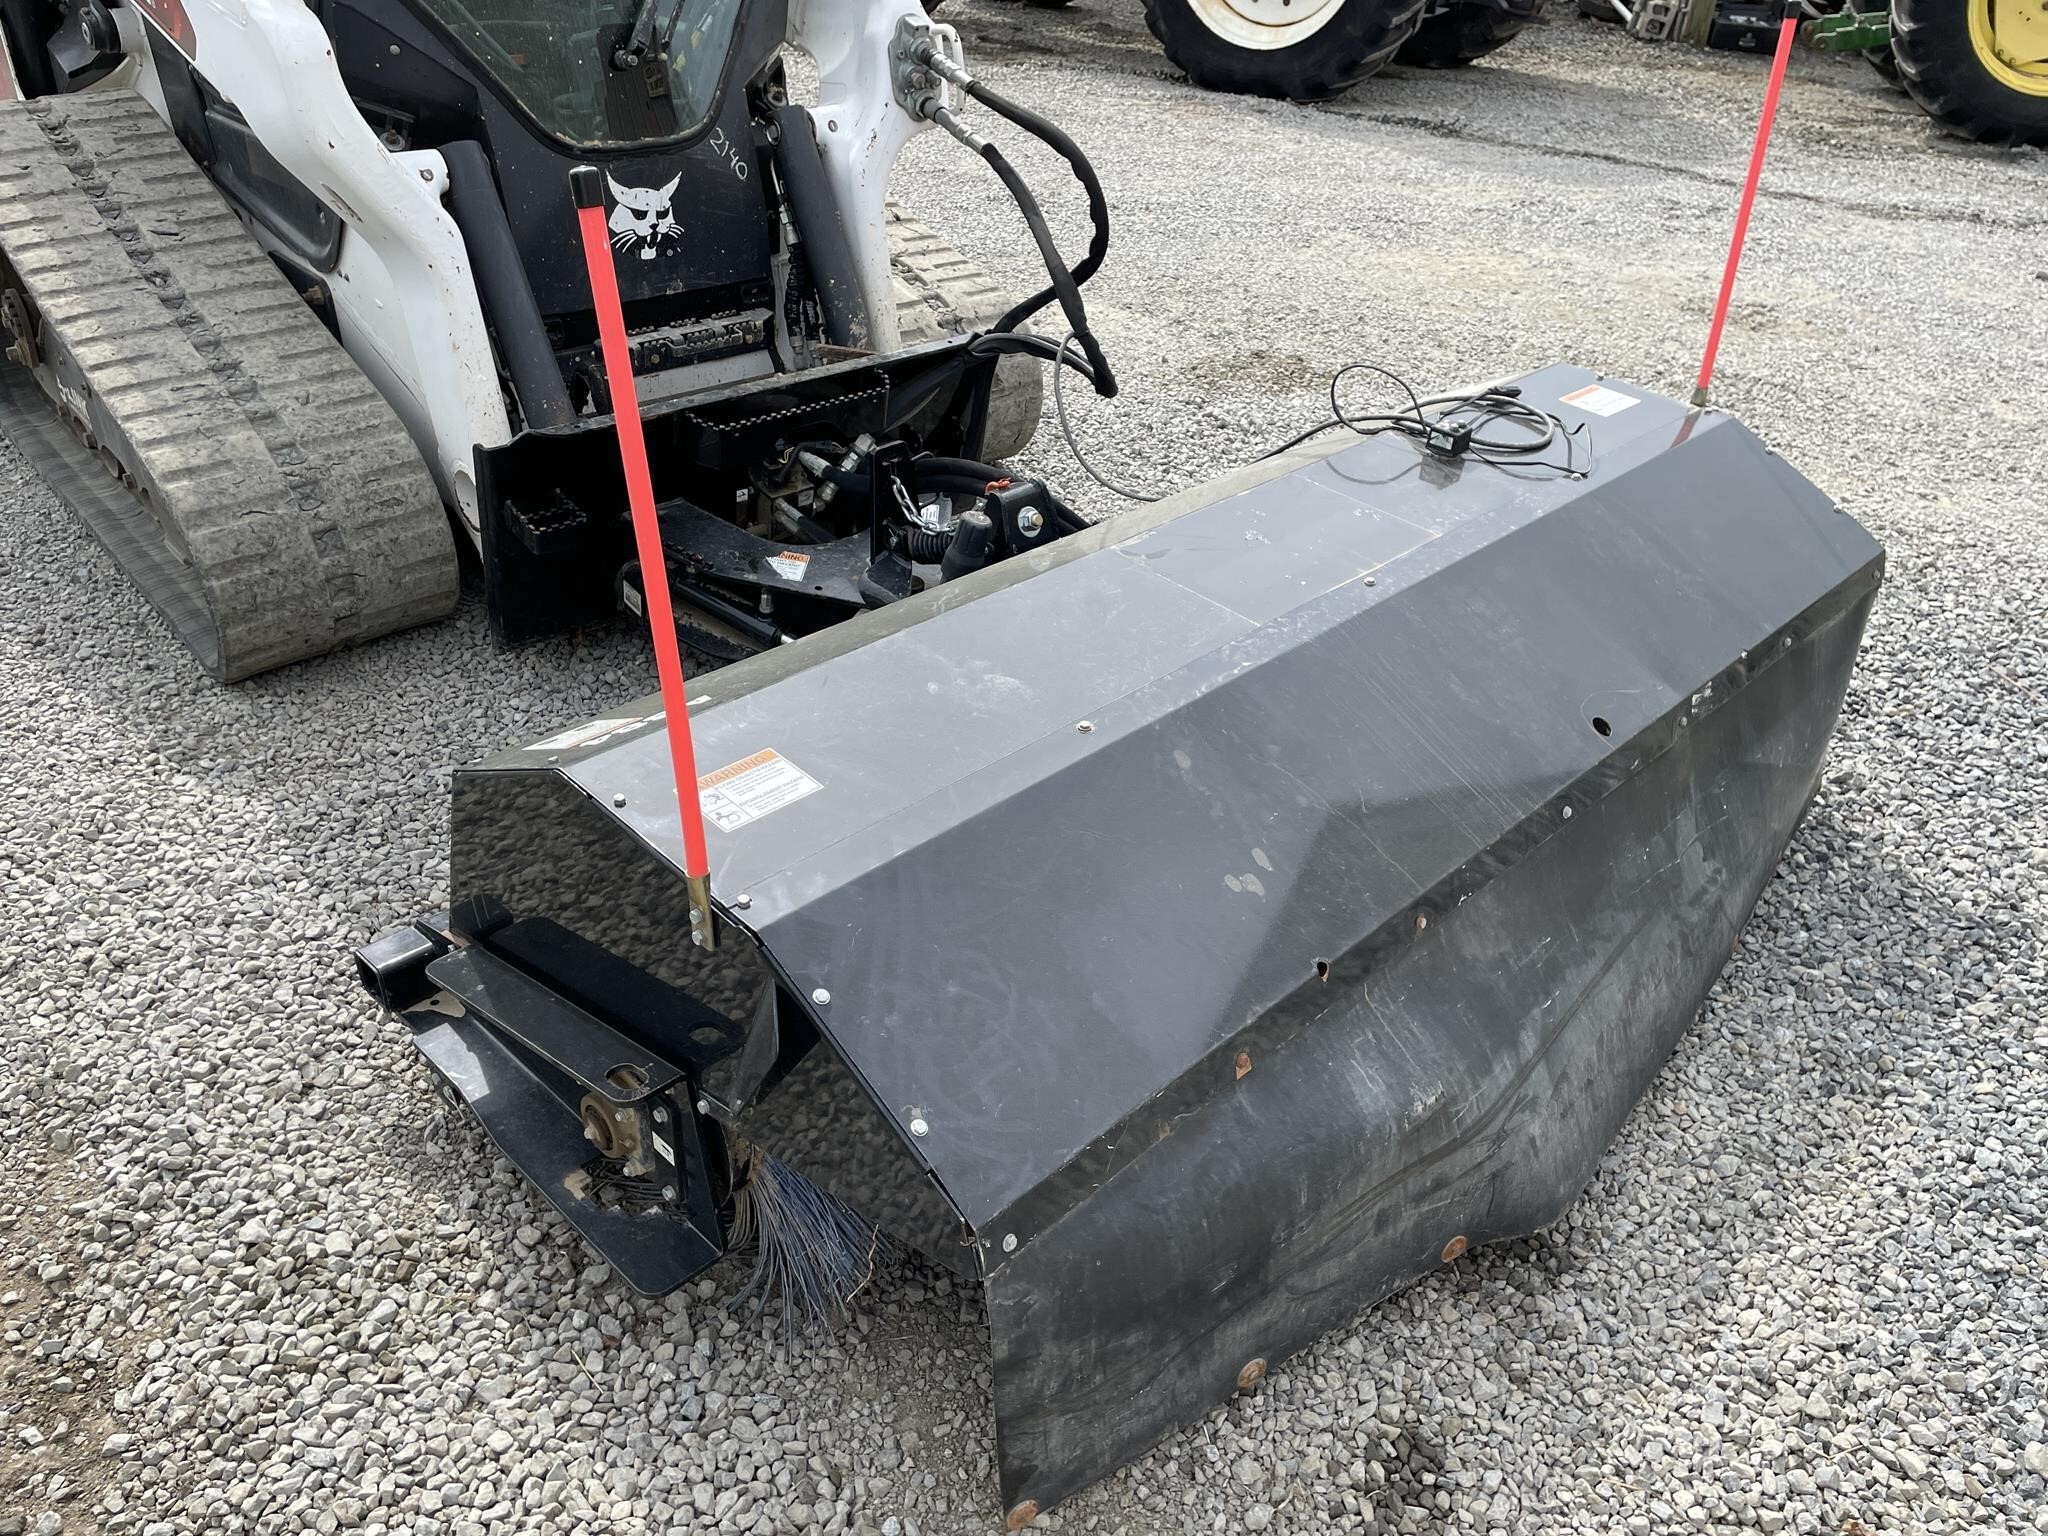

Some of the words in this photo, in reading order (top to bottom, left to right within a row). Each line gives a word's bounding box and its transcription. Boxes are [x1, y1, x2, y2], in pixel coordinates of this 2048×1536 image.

[709, 127, 748, 181] 2140
[780, 553, 804, 561] NING
[699, 755, 766, 787] WARNING
